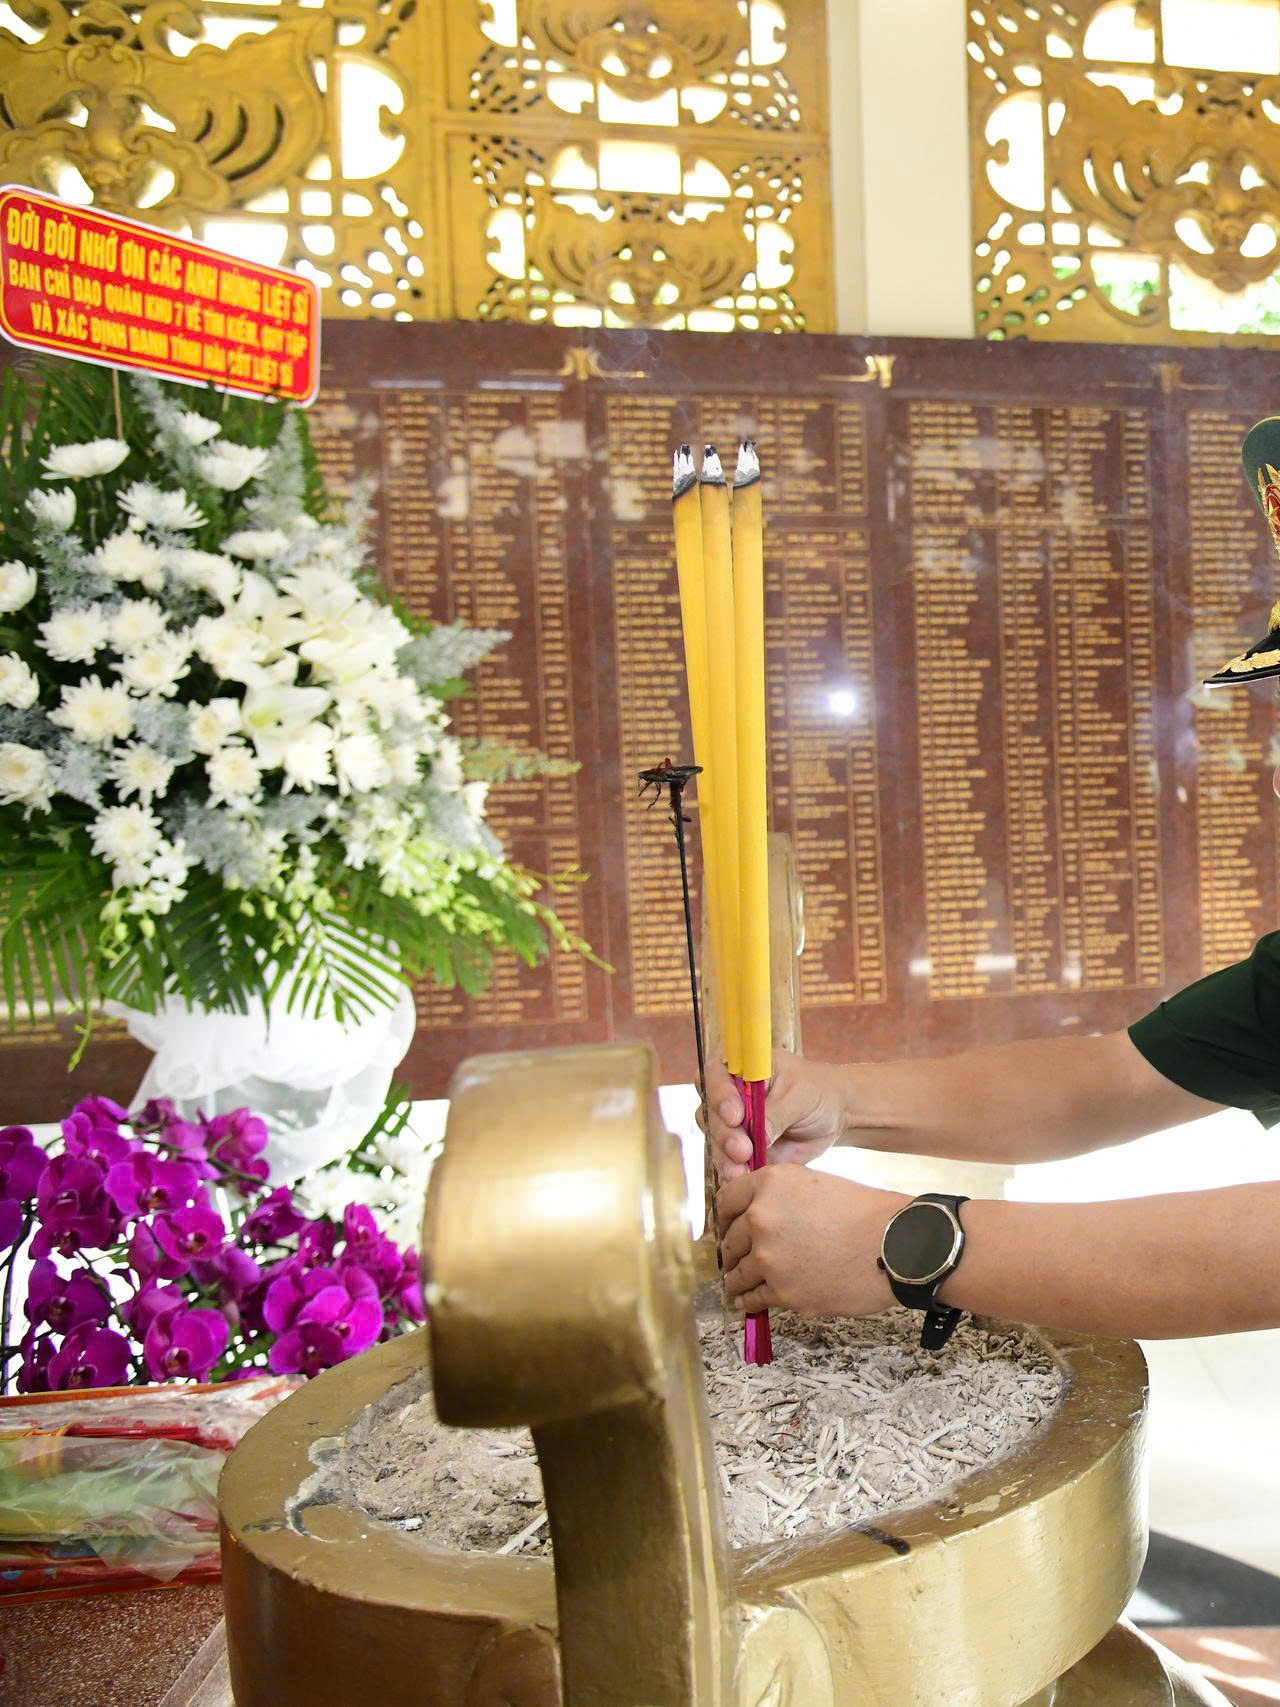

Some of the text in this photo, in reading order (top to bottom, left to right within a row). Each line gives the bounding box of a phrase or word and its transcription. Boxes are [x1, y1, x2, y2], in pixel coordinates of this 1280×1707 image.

[8, 258, 41, 292] BAN
[44, 263, 71, 299] CHỈ
[72, 274, 103, 310] ĐẠO
[104, 281, 144, 318] QUÂN
[144, 293, 173, 325] KHU
[173, 301, 184, 327] 7
[185, 298, 202, 332] VỀ
[80, 230, 119, 272] NHỚ
[121, 239, 146, 280] ƠN
[148, 246, 183, 290] CÁC
[184, 260, 218, 301] ANH
[219, 267, 261, 313] HÙNG
[263, 280, 292, 326] LIỆT
[31, 298, 53, 333] VÀ
[56, 305, 88, 340] XÁC
[90, 316, 128, 353] ĐỊNH
[129, 326, 169, 360] DANH
